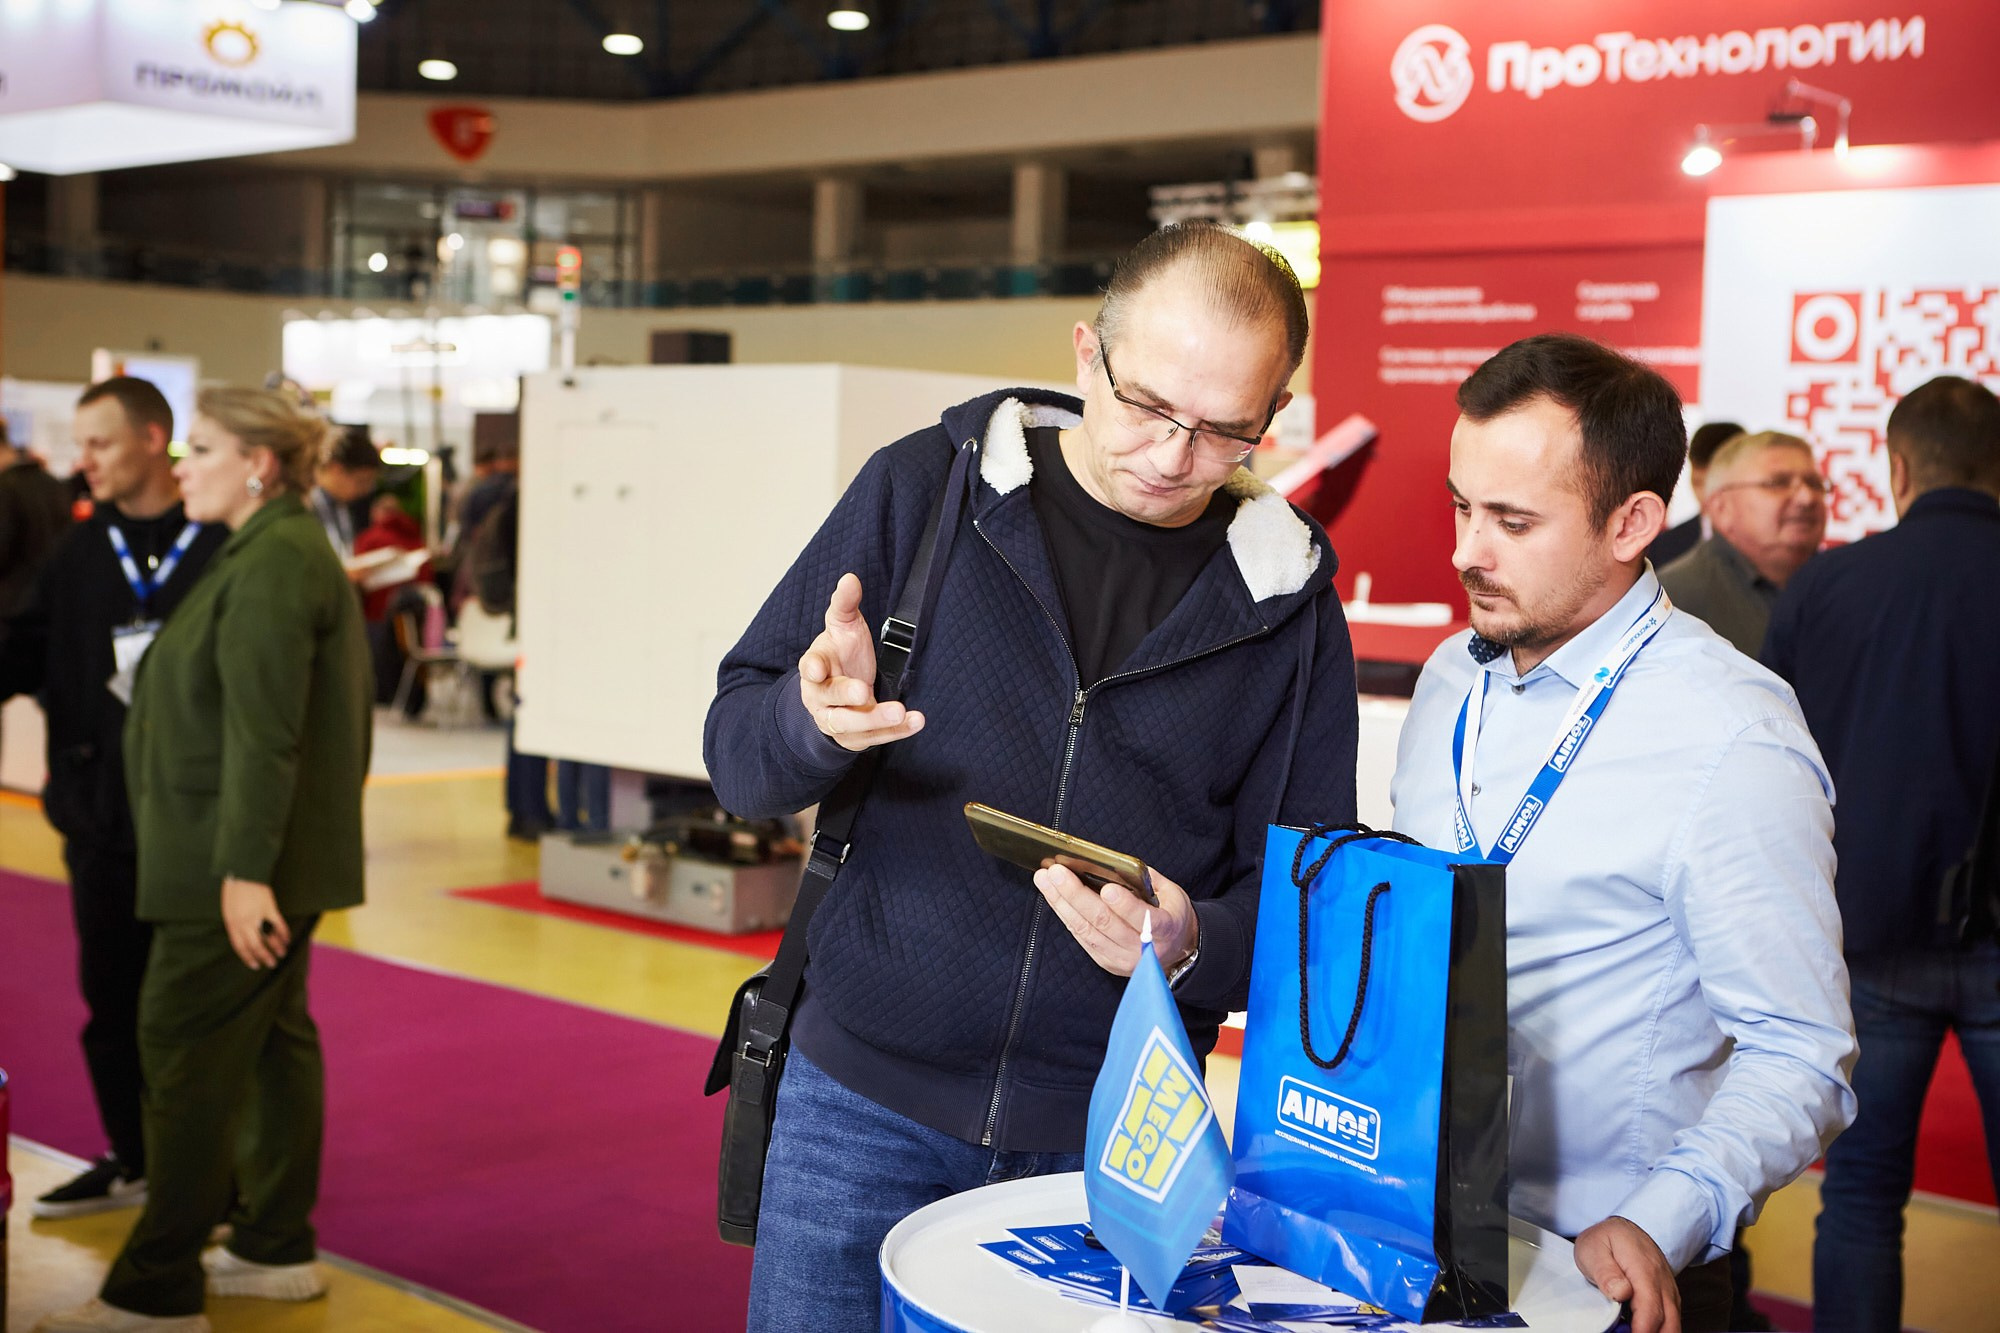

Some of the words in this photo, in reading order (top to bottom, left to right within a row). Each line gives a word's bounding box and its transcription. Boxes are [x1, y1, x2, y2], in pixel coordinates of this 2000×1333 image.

[1487, 15, 1925, 98] ПроТехнологии
[1503, 801, 1540, 850] AIMOL
[1126, 1065, 1192, 1181] MEGO
